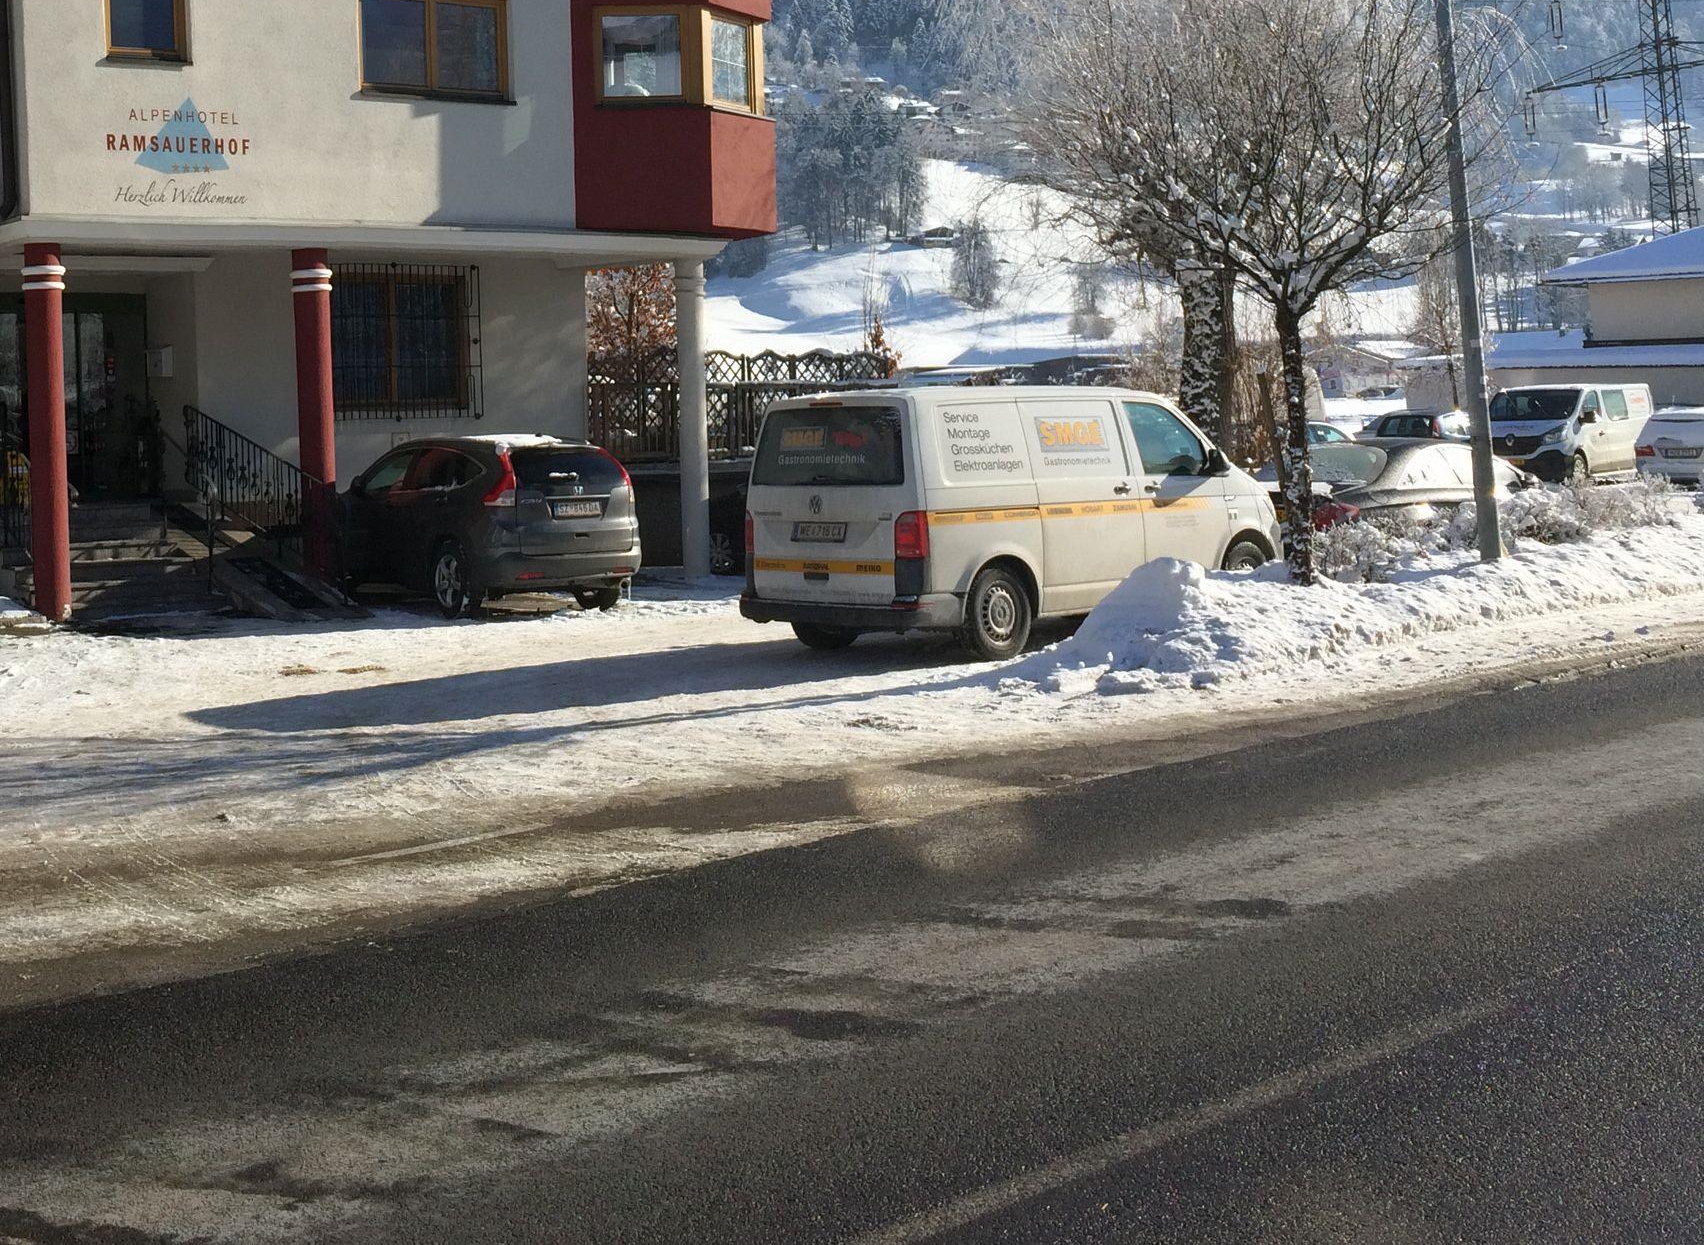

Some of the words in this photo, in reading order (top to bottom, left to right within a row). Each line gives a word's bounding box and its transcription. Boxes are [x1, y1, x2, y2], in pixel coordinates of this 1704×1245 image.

[128, 108, 239, 125] ALPENHOTEL
[106, 134, 250, 155] RAMSAUERHOF
[114, 179, 175, 206] Herzlich
[172, 182, 248, 205] Willkommen
[942, 411, 979, 424] Service
[947, 428, 991, 441] Montage
[951, 443, 1014, 456] Grossküchen
[777, 454, 866, 466] Gastronomietechnik
[954, 459, 1024, 473] Elektroanlagen
